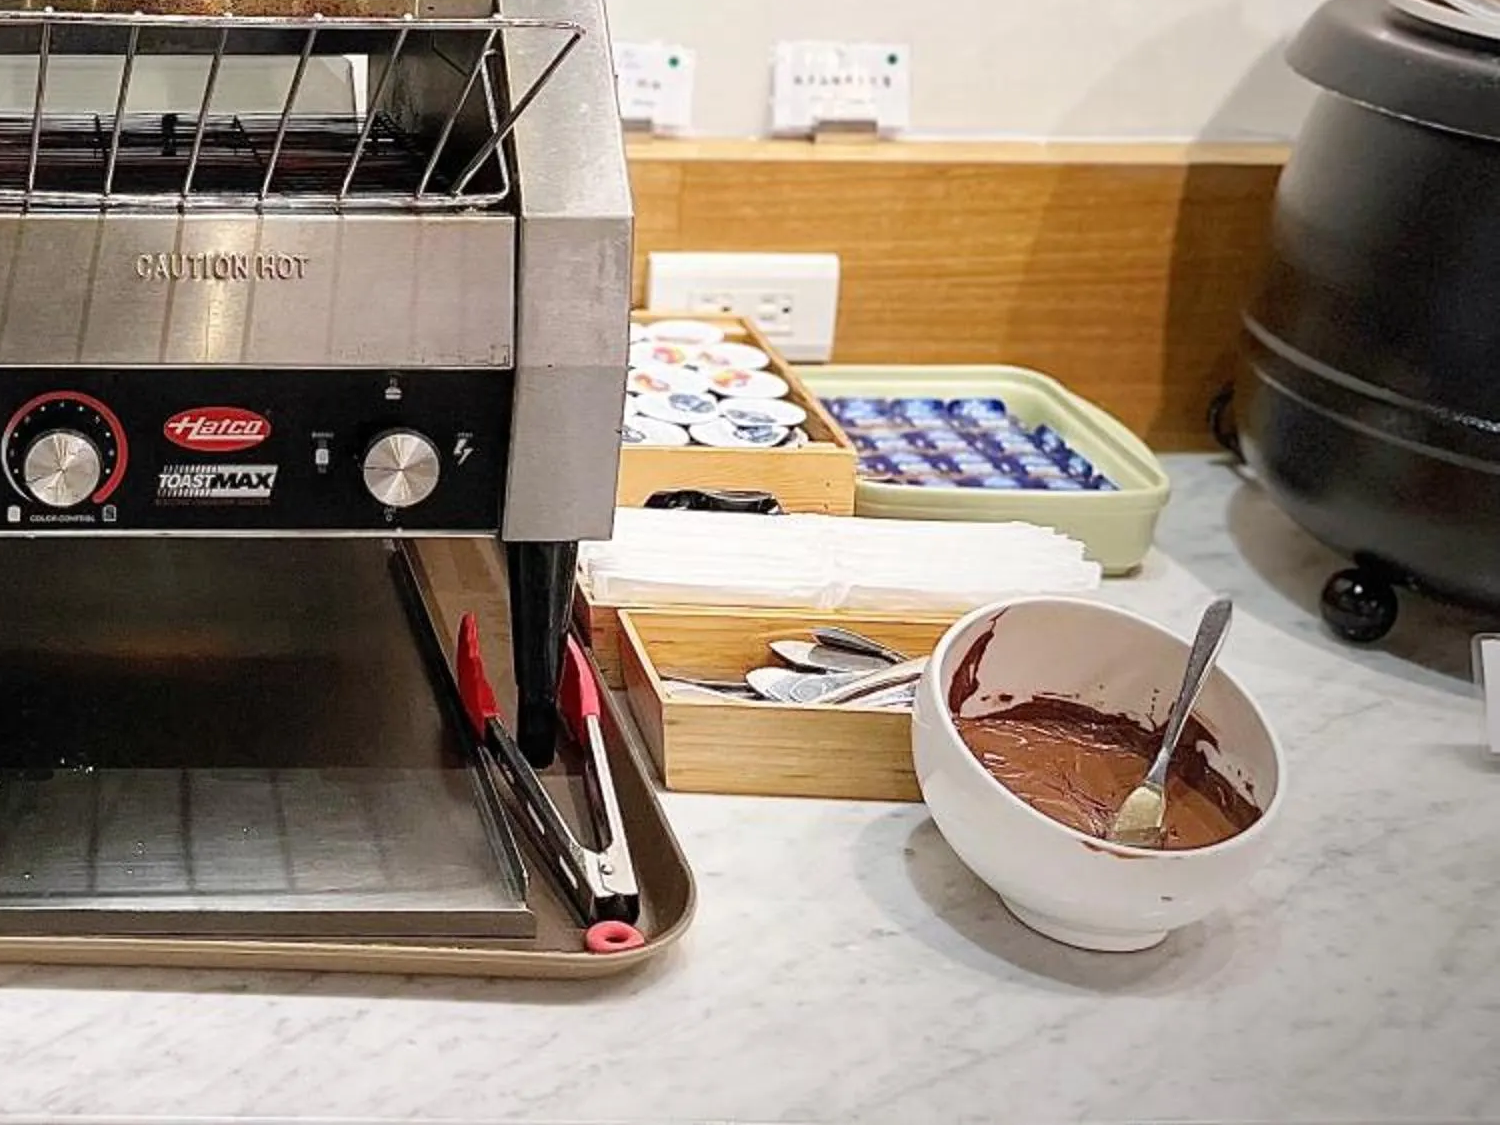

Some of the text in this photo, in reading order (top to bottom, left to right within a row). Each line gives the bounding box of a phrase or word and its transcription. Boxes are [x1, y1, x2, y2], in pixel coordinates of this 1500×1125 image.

[136, 251, 310, 281] CAUTION HOT
[167, 415, 264, 441] Hatco
